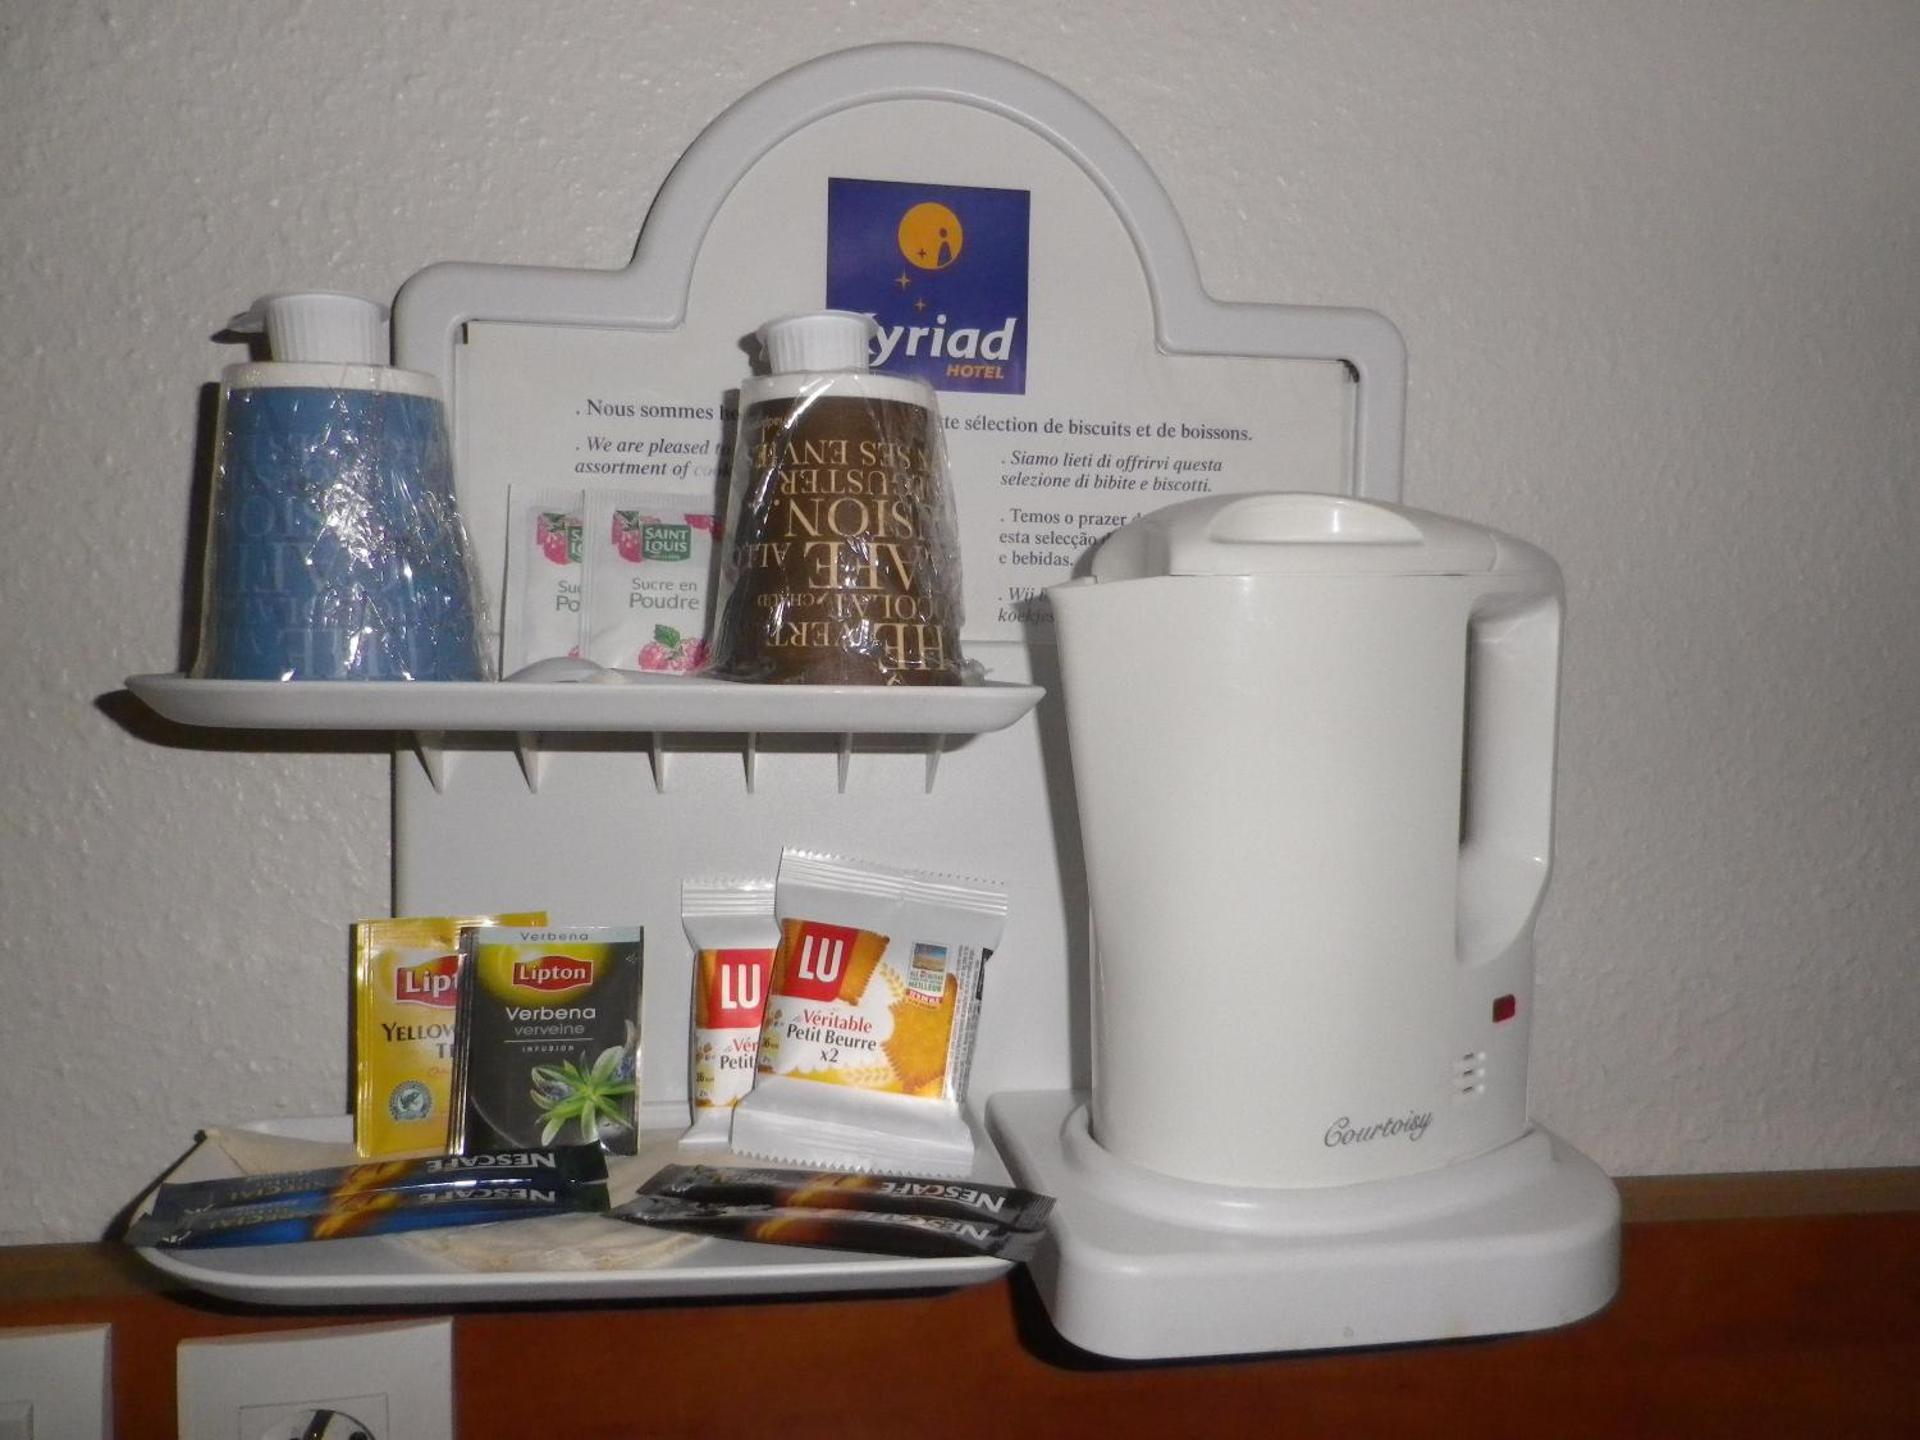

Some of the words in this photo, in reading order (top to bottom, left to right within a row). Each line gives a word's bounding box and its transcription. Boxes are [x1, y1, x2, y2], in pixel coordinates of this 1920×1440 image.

[947, 364, 1004, 379] HOTEL
[587, 399, 635, 418] Nous
[640, 405, 714, 420] sommes
[964, 413, 1038, 433] sélection
[1044, 418, 1064, 434] de
[1069, 418, 1131, 437] biscuits
[1136, 424, 1152, 438] et
[1156, 422, 1177, 439] de
[1181, 421, 1253, 442] boissons.
[587, 436, 612, 452] We
[616, 441, 645, 453] are
[647, 438, 710, 458] pleased
[574, 461, 667, 476] assortment
[672, 461, 691, 479] of
[1011, 450, 1059, 467] Siamo
[1063, 452, 1092, 468] lieti
[1097, 452, 1112, 469] di
[1115, 454, 1169, 472] offrirvi
[1173, 458, 1222, 474] questa
[1000, 474, 1070, 490] selezione
[1075, 474, 1090, 489] di
[1094, 475, 1136, 491] bibite
[1140, 481, 1148, 491] e
[1152, 476, 1212, 493] biscotti.
[1011, 509, 1060, 525] Temos
[1064, 514, 1074, 525] o
[1078, 513, 1127, 529] prazer
[645, 527, 689, 541] SAINT
[999, 532, 1030, 544] esta
[1034, 531, 1097, 549] selecção
[645, 541, 687, 553] LOUIS
[999, 553, 1007, 565] e
[1012, 550, 1074, 568] bebidas.
[631, 577, 674, 592] Sucre
[679, 581, 697, 592] en
[556, 595, 580, 612] Po
[629, 593, 699, 611] Poudre
[520, 931, 589, 942] Verbena
[798, 935, 843, 983] LU
[519, 964, 586, 984] Lipton
[720, 963, 761, 1010] LU
[506, 1006, 596, 1020] Verbena
[802, 1008, 873, 1033] Véritable
[514, 1024, 585, 1037] verveine
[787, 1022, 821, 1044] Petit
[824, 1029, 877, 1051] Beurre
[720, 1054, 754, 1070] Petit
[820, 1049, 839, 1063] x2
[1324, 1110, 1434, 1148] Courtoisy
